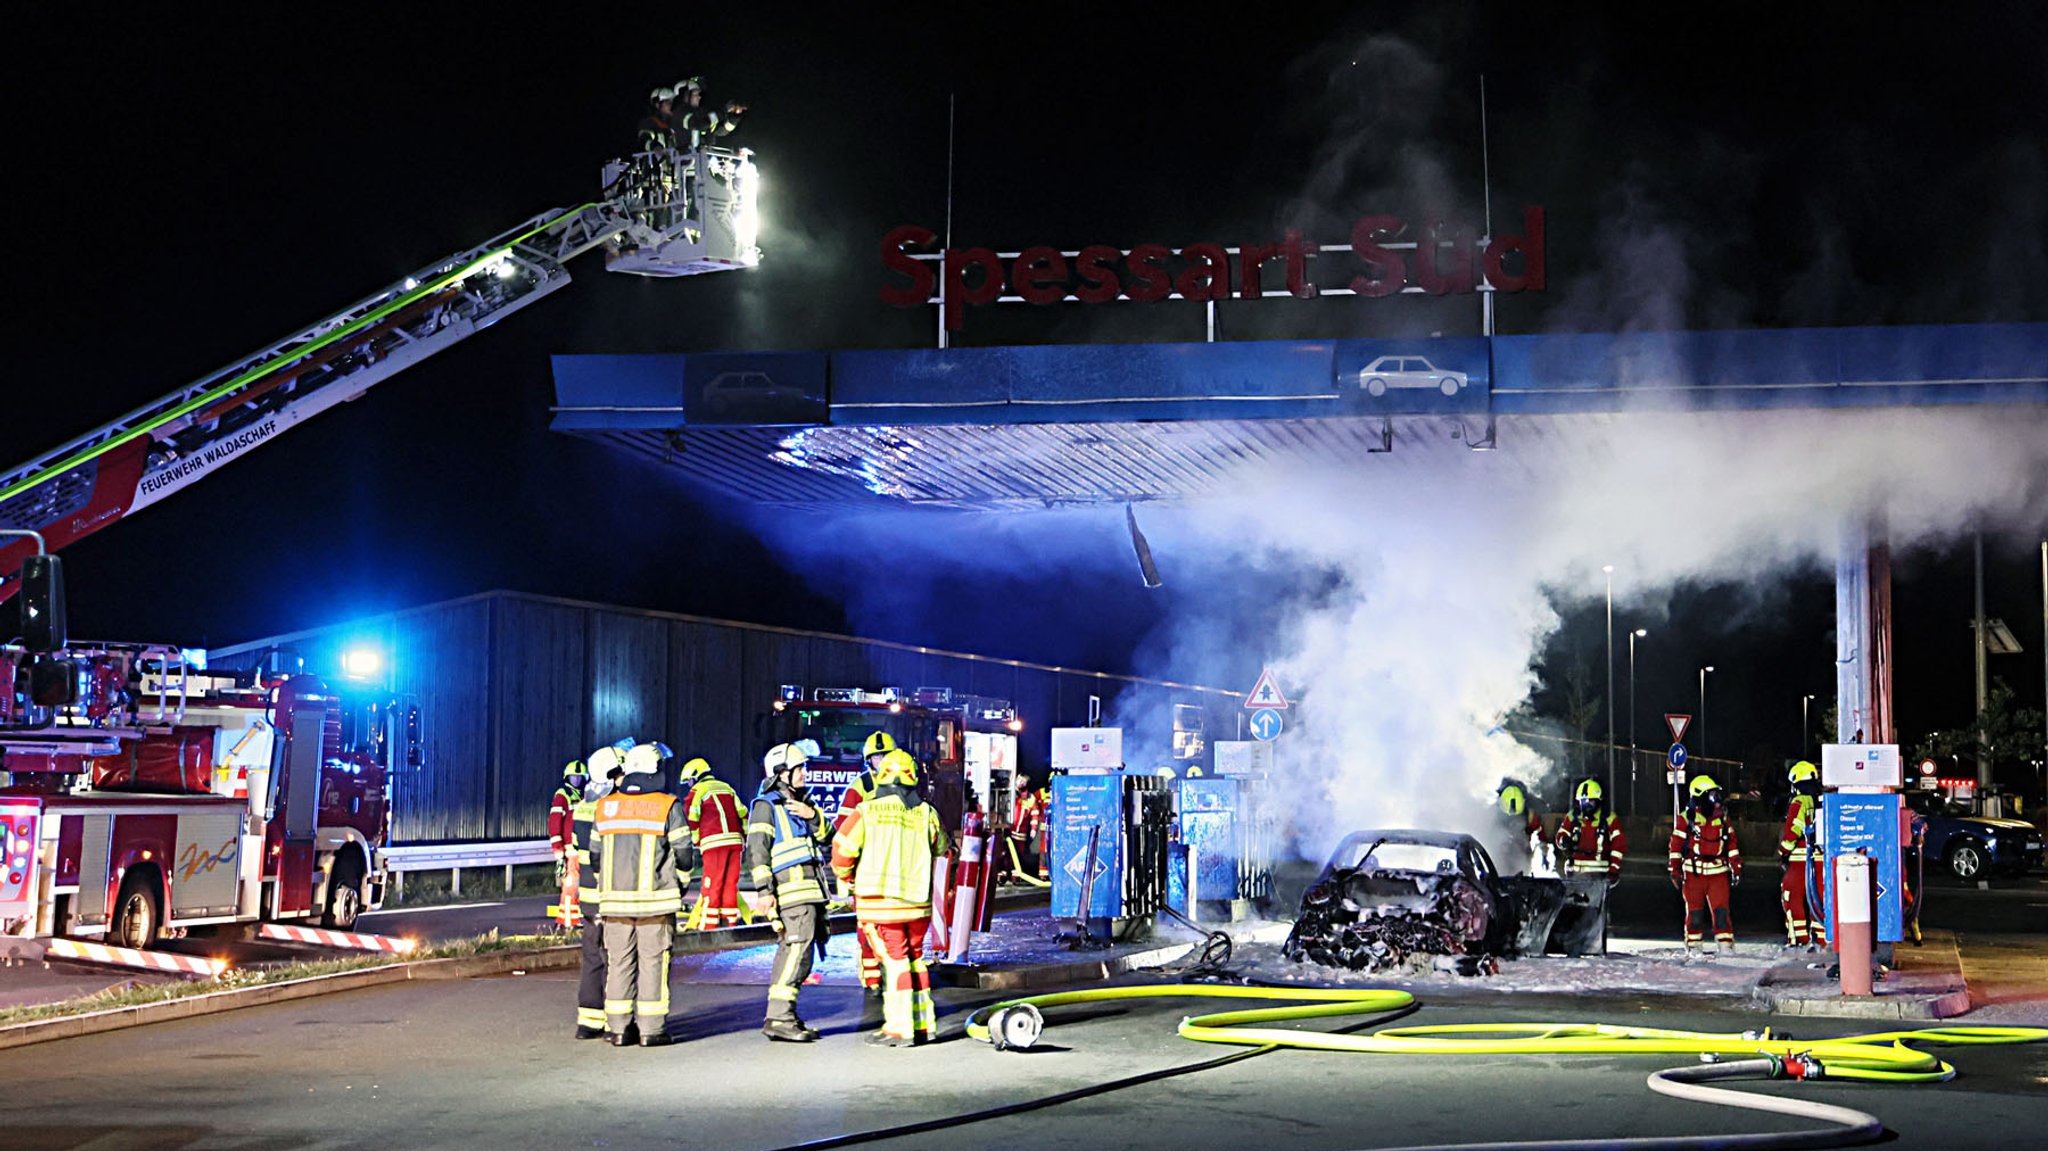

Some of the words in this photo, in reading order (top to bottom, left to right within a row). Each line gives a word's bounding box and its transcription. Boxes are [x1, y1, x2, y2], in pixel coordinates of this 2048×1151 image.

[880, 224, 1318, 330] Spessart
[1349, 206, 1545, 298] Süd
[141, 456, 204, 495] FEUERWEHR
[204, 420, 276, 464] WALDASCHAFF
[1069, 861, 1102, 873] ARL
